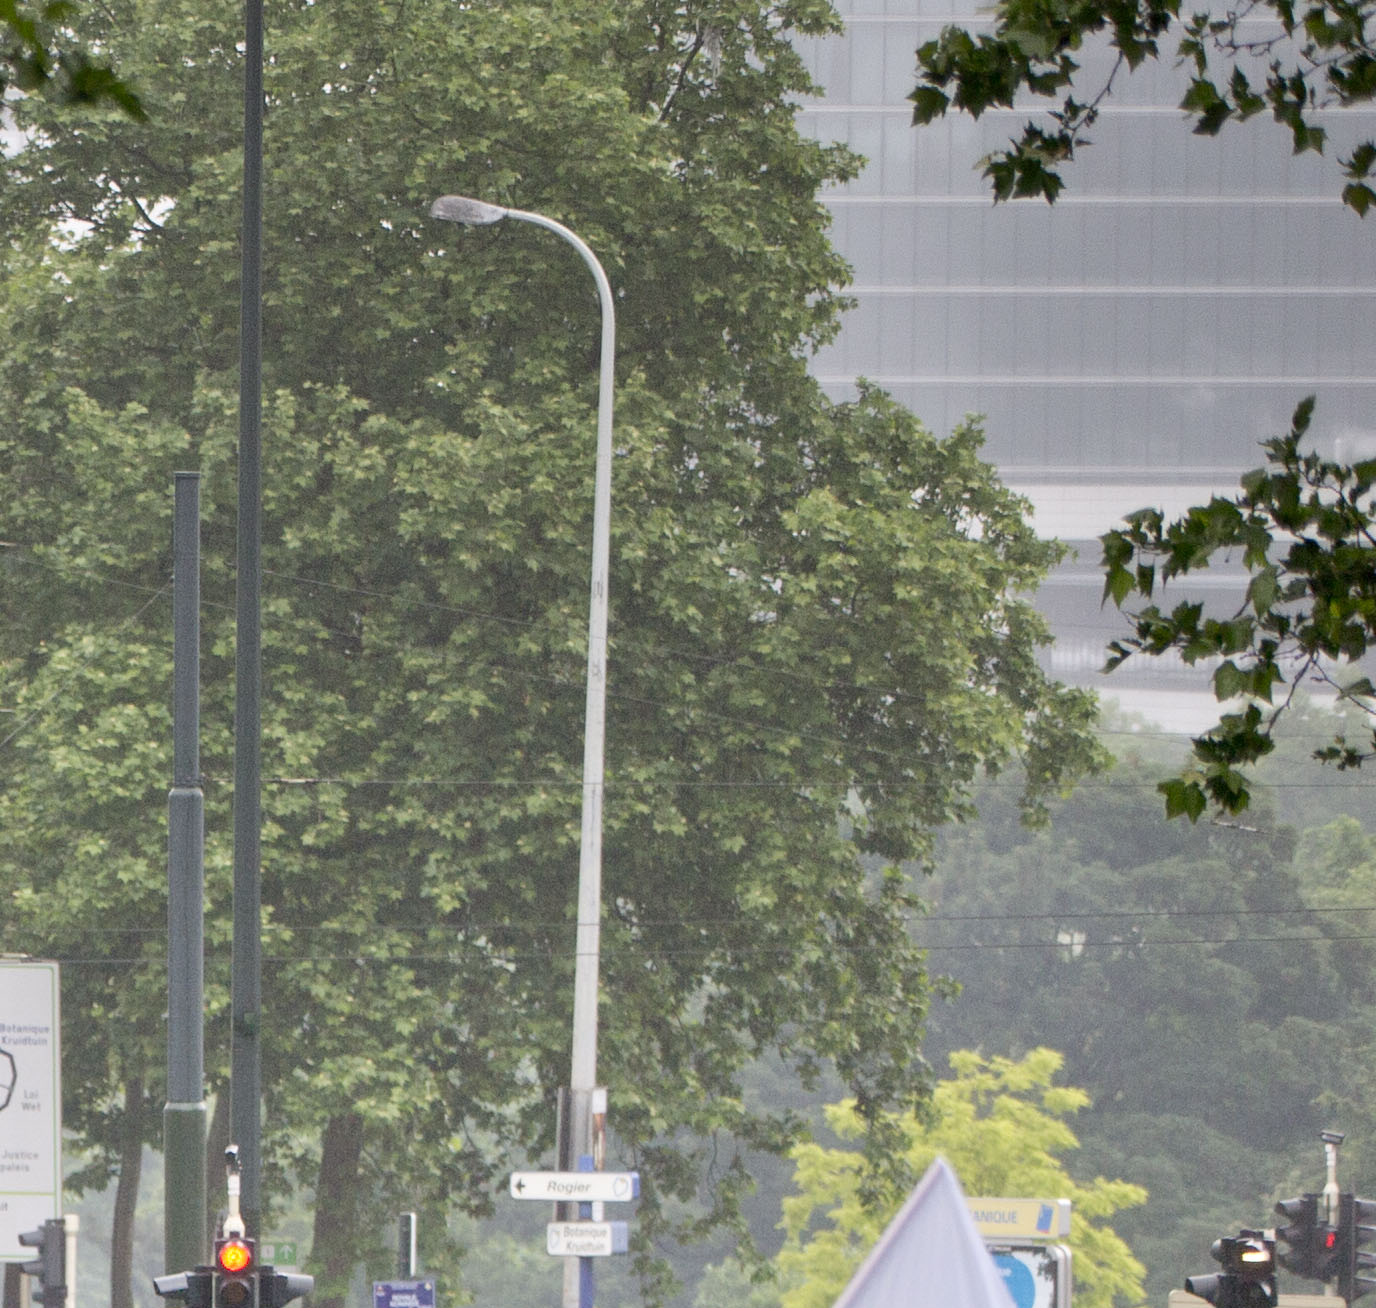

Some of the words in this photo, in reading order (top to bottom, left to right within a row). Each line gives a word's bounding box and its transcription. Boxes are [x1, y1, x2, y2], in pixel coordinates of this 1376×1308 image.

[0, 1023, 50, 1035] Botanique
[1, 1036, 48, 1046] Kruidtuin
[24, 1089, 39, 1099] Loi
[21, 1102, 41, 1111] Wet
[1, 1150, 39, 1160] Justice
[546, 1180, 592, 1194] Rogier
[972, 1210, 1019, 1225] ANIQUE
[563, 1226, 608, 1240] Botanique
